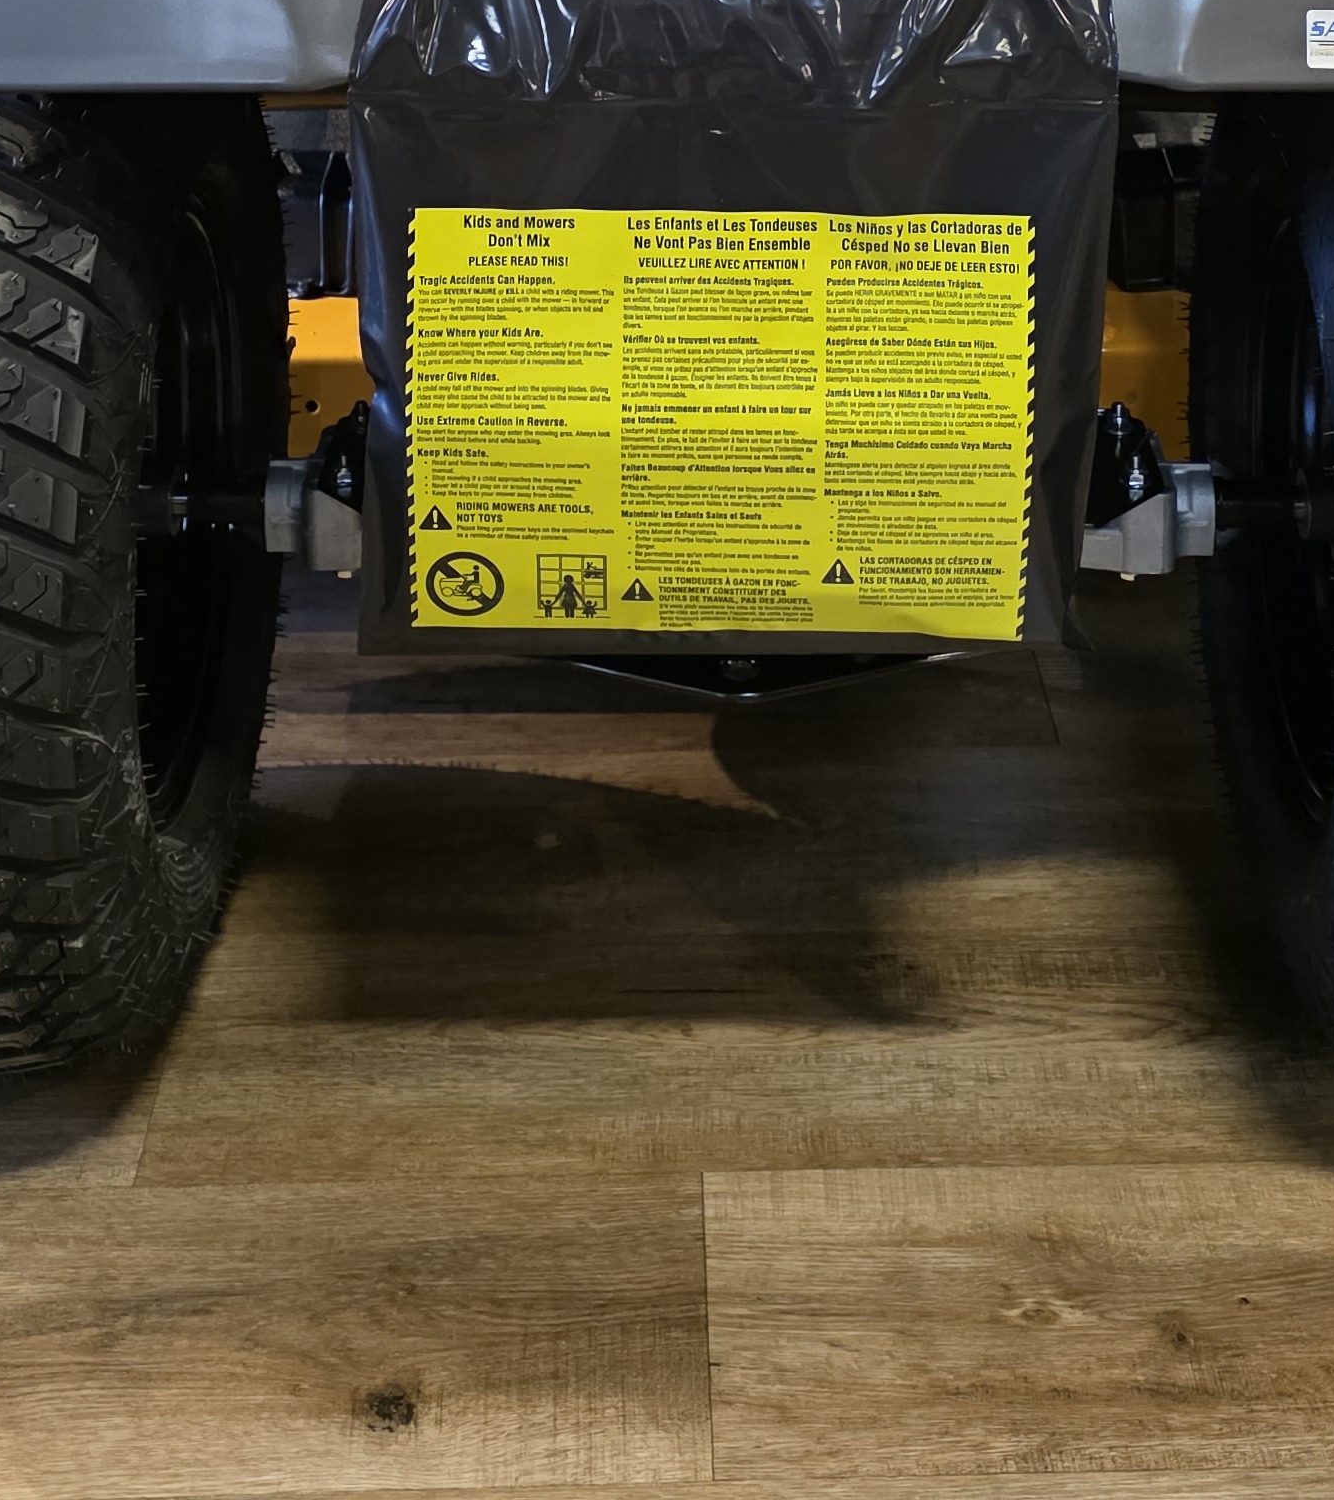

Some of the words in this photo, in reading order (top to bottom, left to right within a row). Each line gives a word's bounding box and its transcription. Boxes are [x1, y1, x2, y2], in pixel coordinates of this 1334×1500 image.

[464, 215, 491, 228] Kids
[496, 217, 519, 228] and
[524, 217, 574, 229] Mowers
[628, 217, 650, 230] Les
[655, 217, 702, 230] Enfants
[707, 219, 718, 231] et
[724, 219, 745, 232] Les
[750, 218, 817, 231] Tondeuses
[830, 220, 852, 232] Los
[857, 222, 892, 235] Niños
[897, 221, 903, 237] y
[908, 221, 926, 233] las
[931, 221, 1002, 235] Cortadoras
[1007, 223, 1022, 235] de
[489, 234, 522, 247] Don't
[527, 234, 549, 247] Mix
[634, 236, 650, 249] Ne
[656, 236, 684, 249] Vont
[689, 236, 711, 249] Pas
[717, 237, 744, 250] Bien
[749, 237, 810, 250] Ensemble
[842, 238, 888, 254] Césped
[894, 241, 910, 253] No
[914, 239, 928, 252] se
[934, 239, 976, 253] Llevan
[981, 241, 1009, 254] Bien
[469, 256, 507, 266] PLEASE
[511, 256, 537, 266] READ
[639, 258, 686, 268] VEUILLEZ
[690, 258, 711, 268] LIRE
[714, 259, 740, 269] AVEC
[743, 259, 798, 270] ATTENTION
[831, 259, 851, 269] POR
[855, 260, 891, 271] FAVOR,
[917, 261, 941, 271] DEJE
[945, 262, 957, 271] DE
[961, 262, 986, 272] LEER
[419, 275, 448, 286] Tragic
[450, 275, 494, 284] Accidents
[498, 275, 514, 284] Can
[518, 275, 555, 286] Happen.
[418, 329, 443, 338] Know
[446, 328, 476, 337] Where
[479, 330, 499, 339] your
[502, 328, 521, 337] Kids
[524, 328, 543, 337] Are.
[418, 373, 444, 382] Never
[447, 372, 467, 381] Give
[471, 372, 499, 381] Rides.
[417, 416, 434, 425] Use
[438, 416, 475, 425] Extreme
[478, 416, 512, 426] Caution
[527, 417, 567, 426] Reverse.
[418, 448, 440, 458] Keep
[443, 448, 463, 457] Kids
[466, 449, 489, 457] Safe.
[457, 502, 489, 510] RIDING
[492, 503, 535, 512] MOWERS
[538, 504, 556, 512] ARE
[559, 504, 593, 514] TOOLS,
[457, 514, 475, 522] NOT
[478, 514, 503, 523] TOYS
[878, 557, 933, 565] CORTADORAS
[948, 556, 979, 565] CÉSPED
[890, 577, 929, 586] TRABAJO,
[932, 577, 943, 585] NO
[945, 577, 989, 585] JUGUETES.
